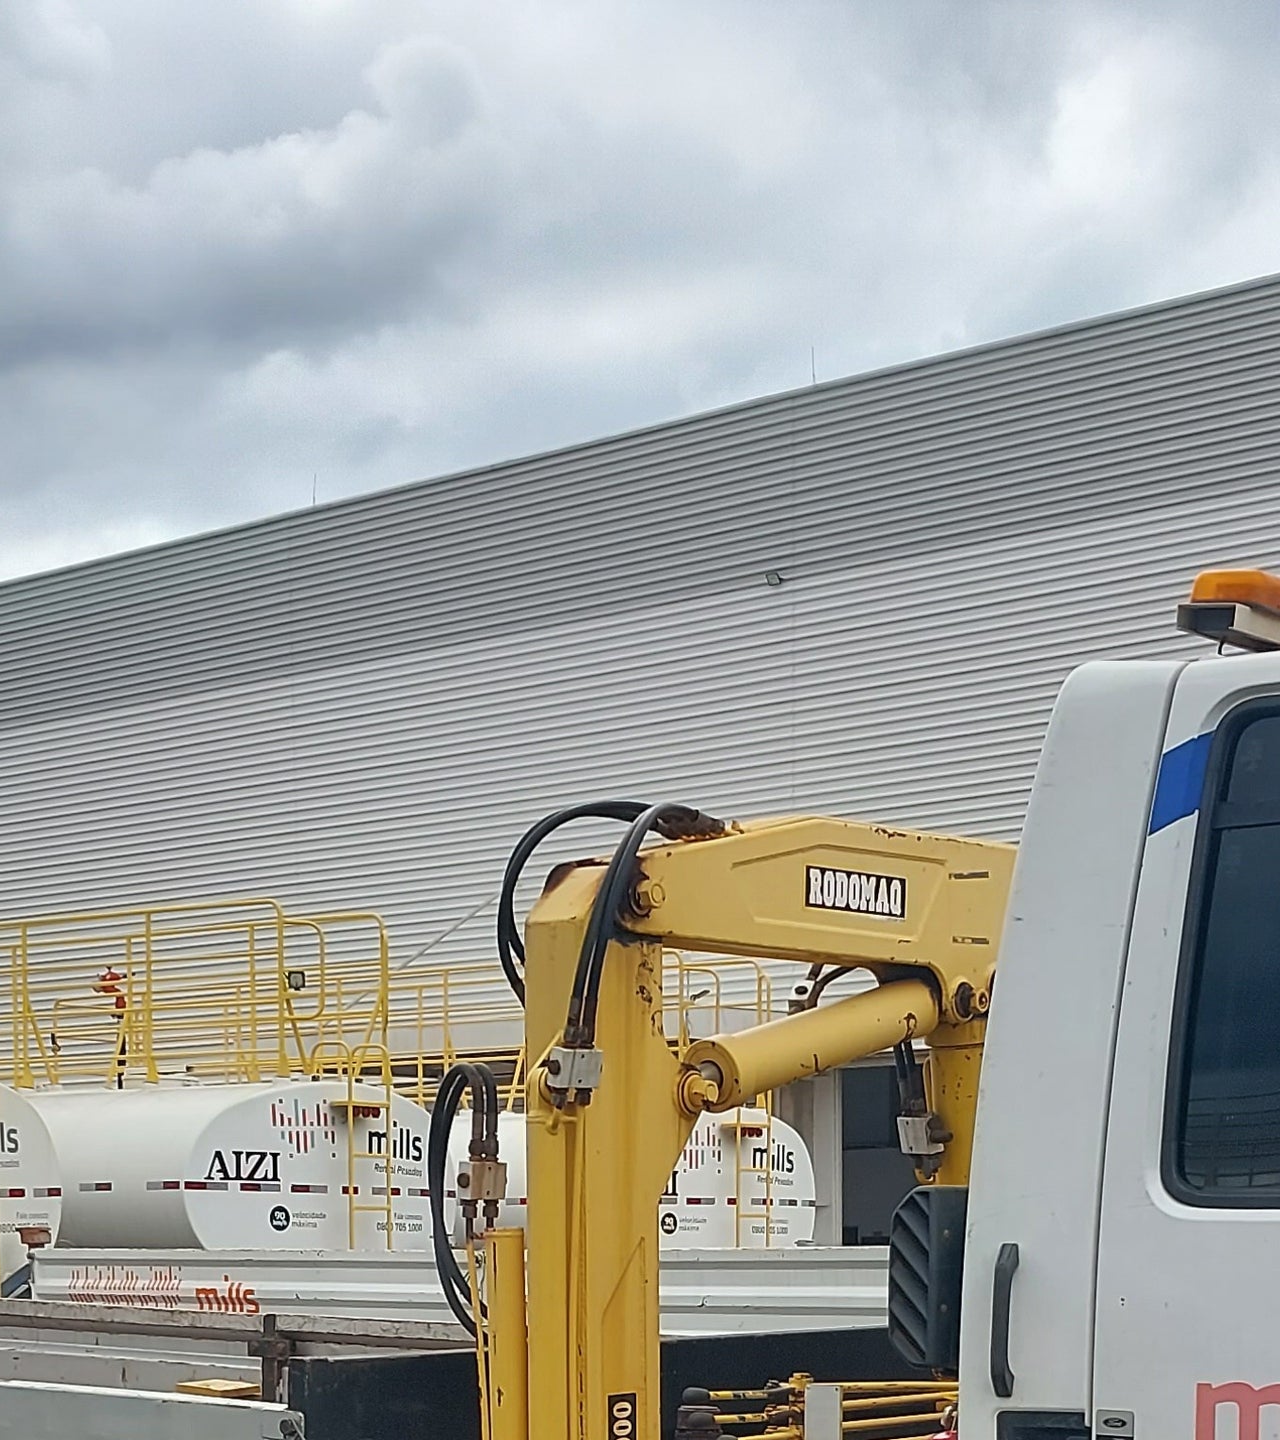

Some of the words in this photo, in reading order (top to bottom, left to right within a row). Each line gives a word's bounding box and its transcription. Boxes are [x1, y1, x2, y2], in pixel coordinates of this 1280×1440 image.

[808, 867, 903, 916] RODOMAQ
[368, 1119, 423, 1162] mills
[752, 1138, 795, 1174] mills
[203, 1149, 282, 1182] AIZI
[195, 1274, 260, 1314] mills
